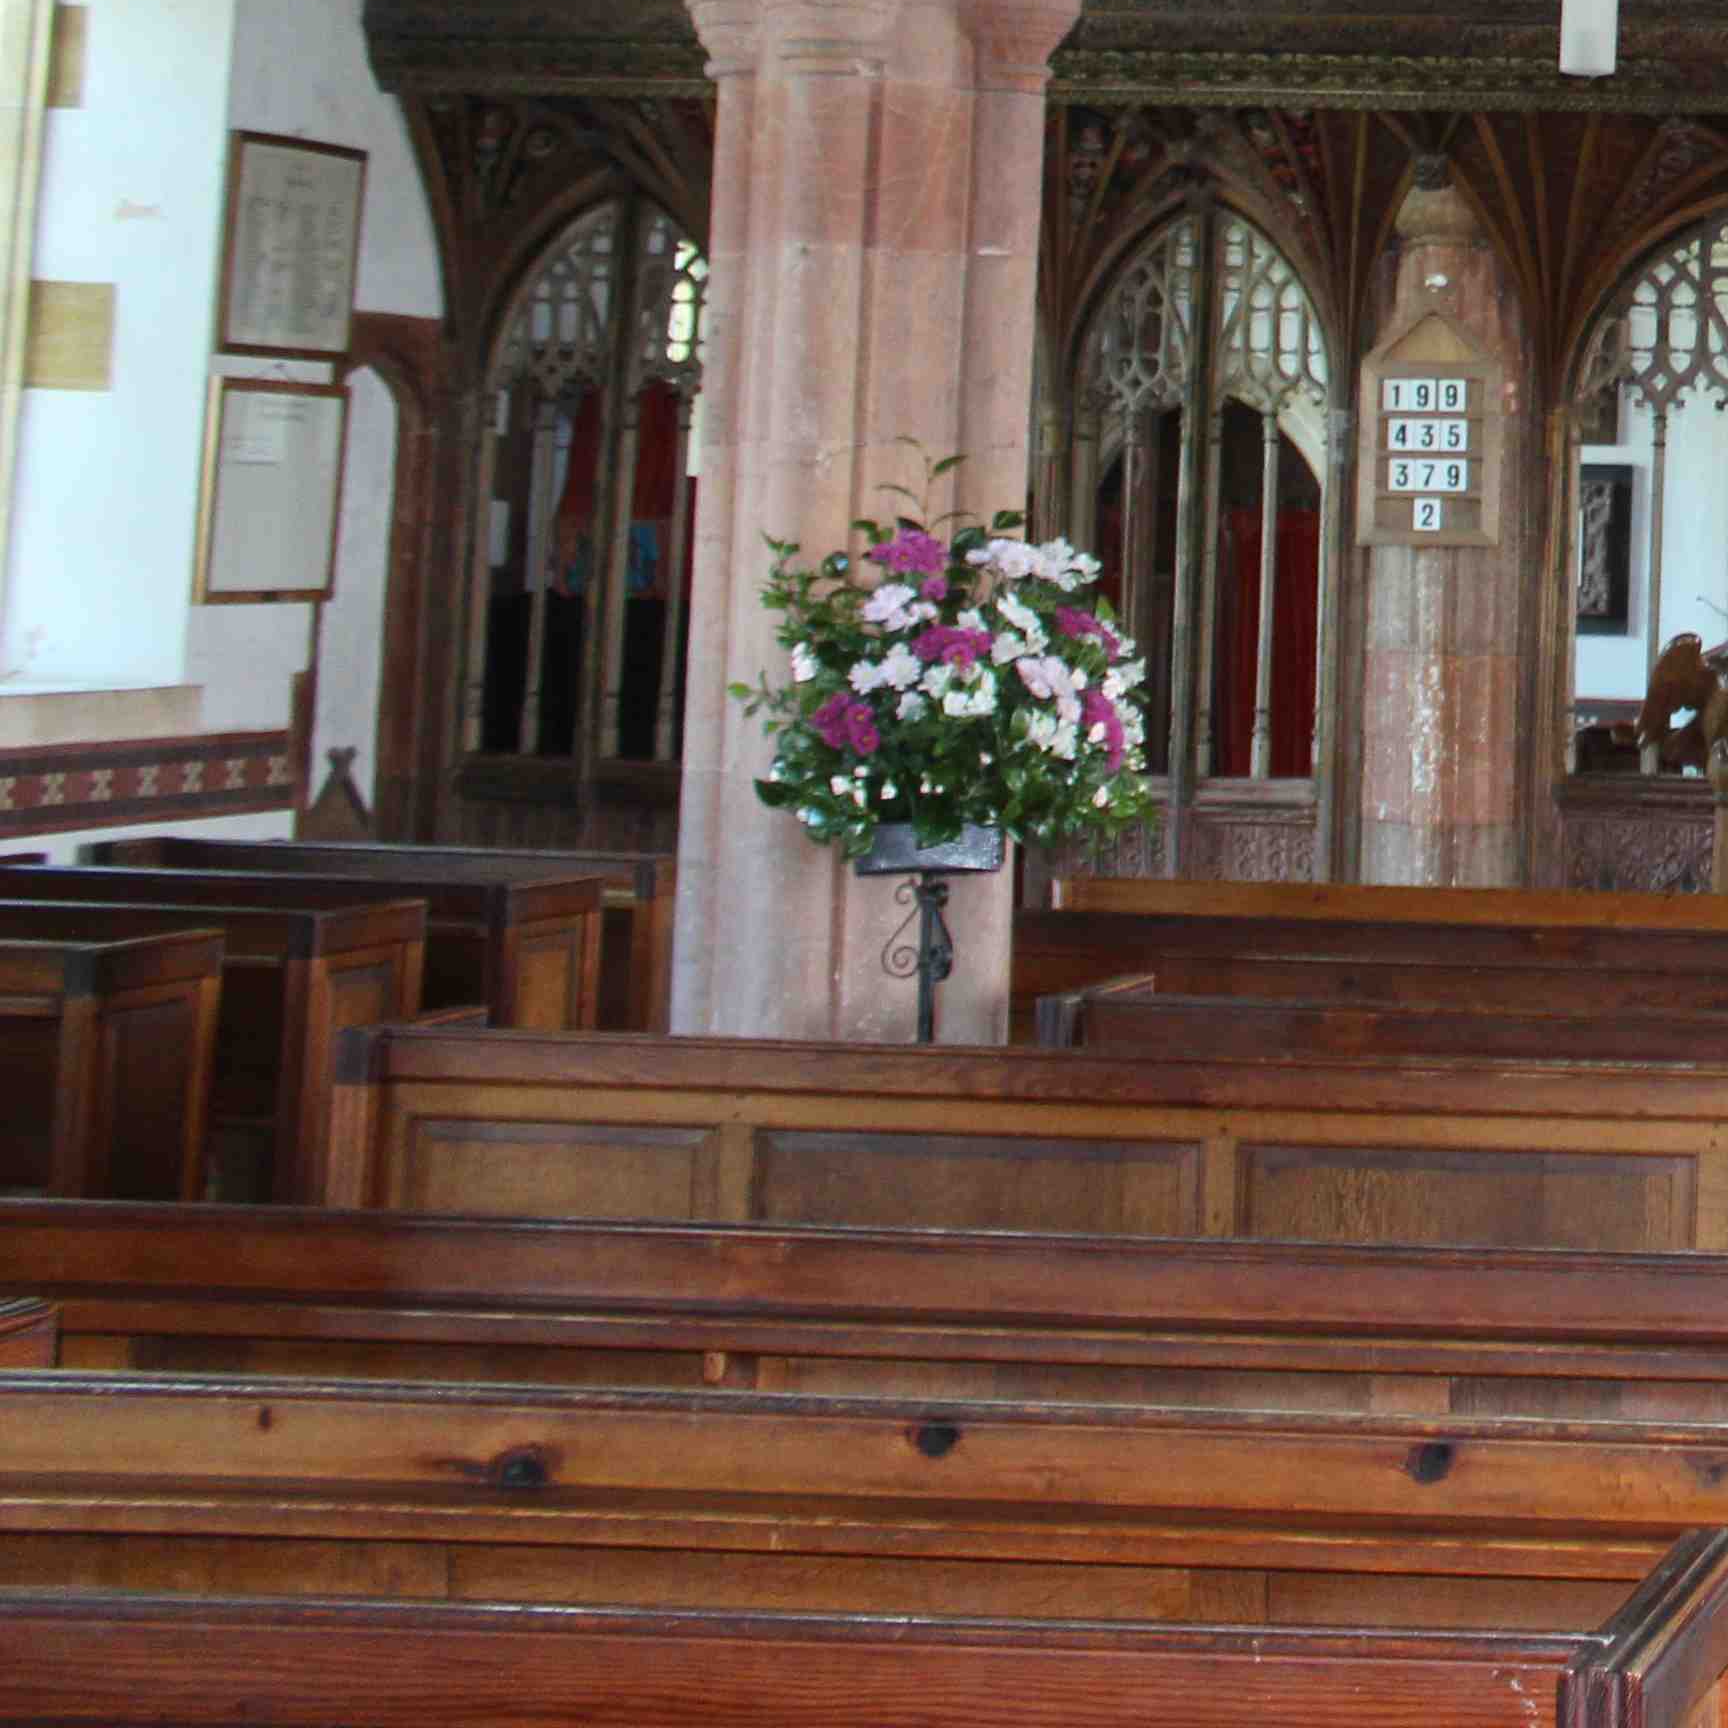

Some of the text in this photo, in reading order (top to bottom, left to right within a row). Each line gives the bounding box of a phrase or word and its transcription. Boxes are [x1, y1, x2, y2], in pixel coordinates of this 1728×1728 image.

[1392, 384, 1458, 408] 199
[1394, 423, 1460, 448] 435
[1395, 463, 1460, 488] 379
[1421, 503, 1434, 527] 2
